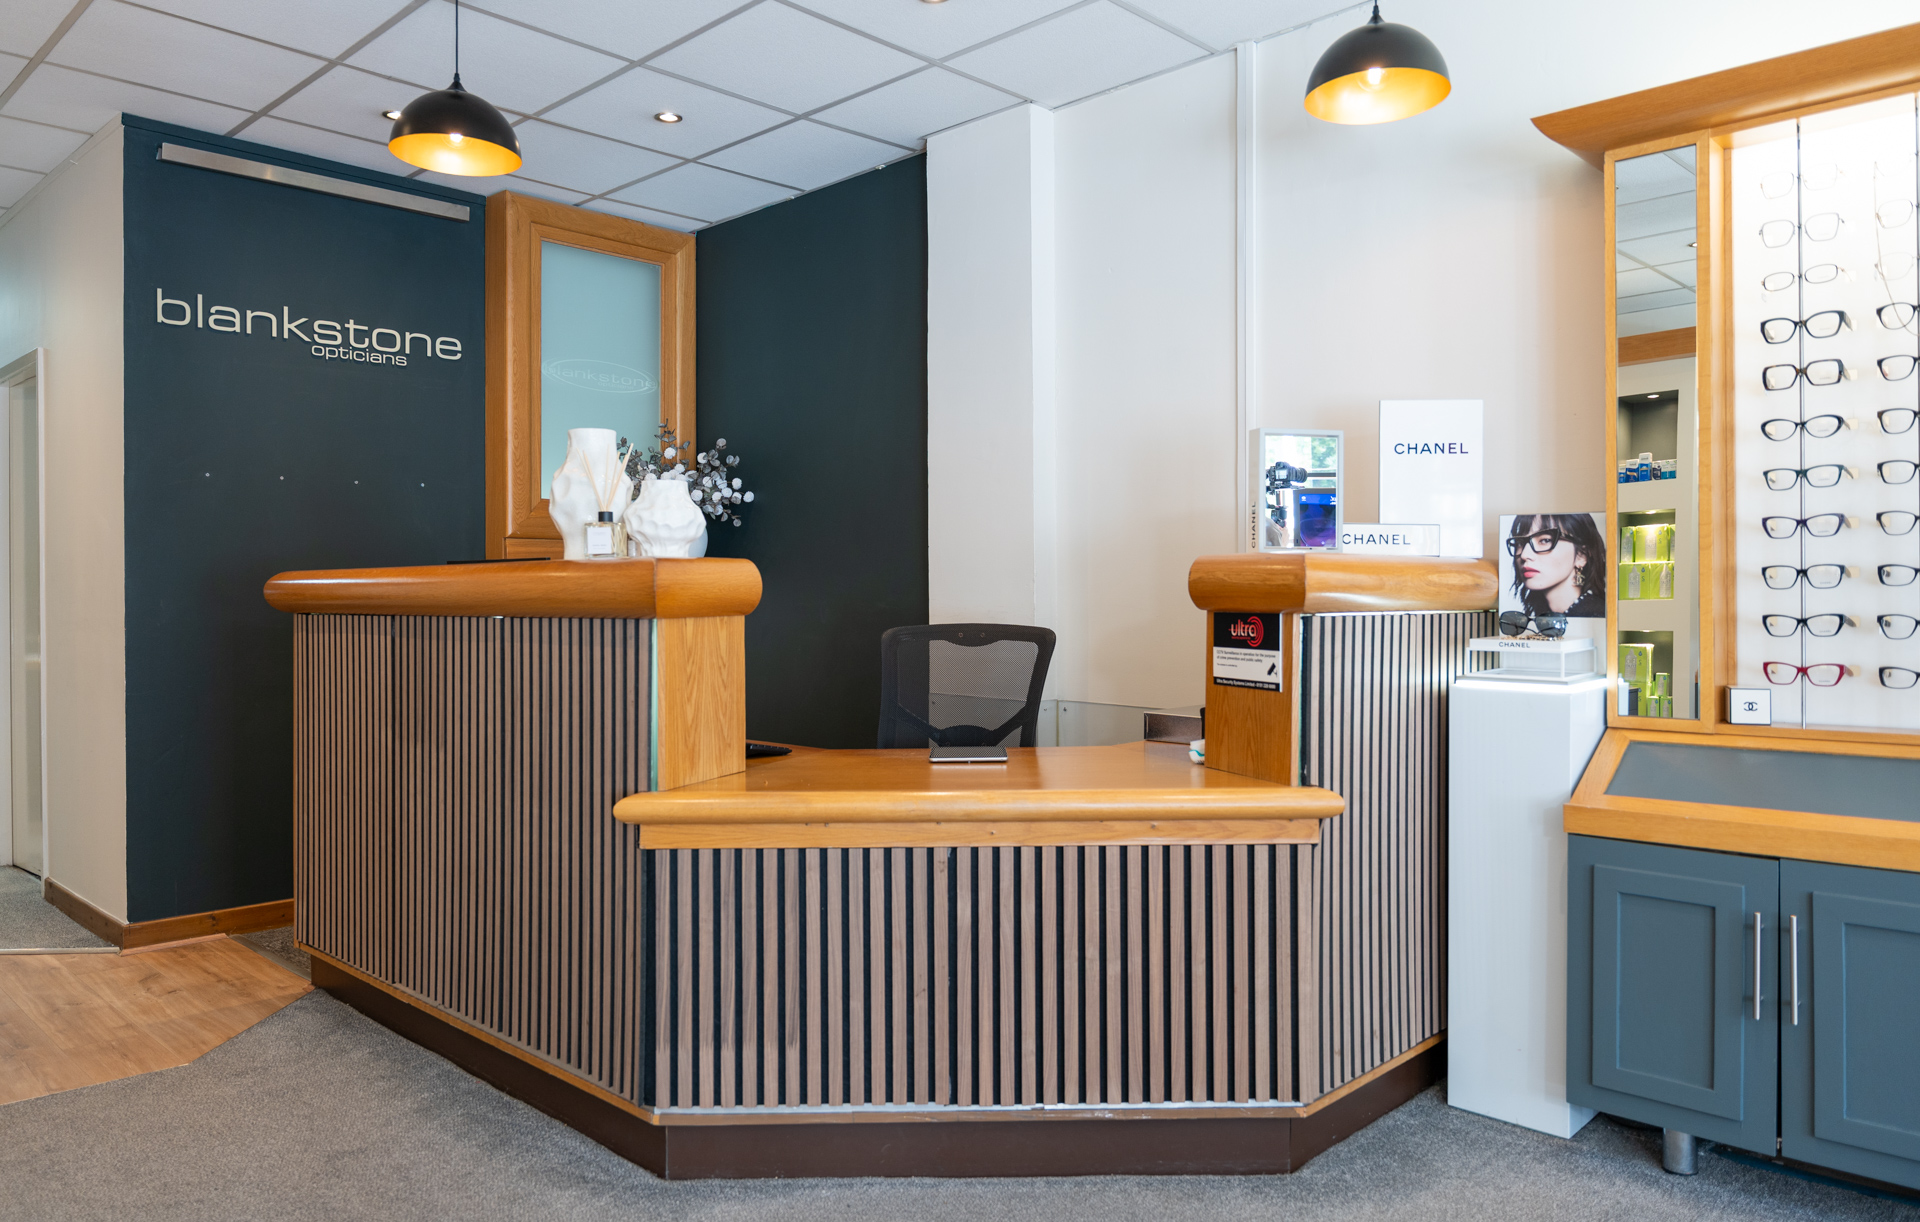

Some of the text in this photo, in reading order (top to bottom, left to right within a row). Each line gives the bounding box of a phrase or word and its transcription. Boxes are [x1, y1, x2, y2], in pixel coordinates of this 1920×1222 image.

[156, 288, 463, 361] blankstone
[311, 344, 408, 367] opticians
[1394, 442, 1469, 455] CHANEL
[1342, 533, 1411, 545] CHANEL
[1231, 619, 1257, 637] ultra
